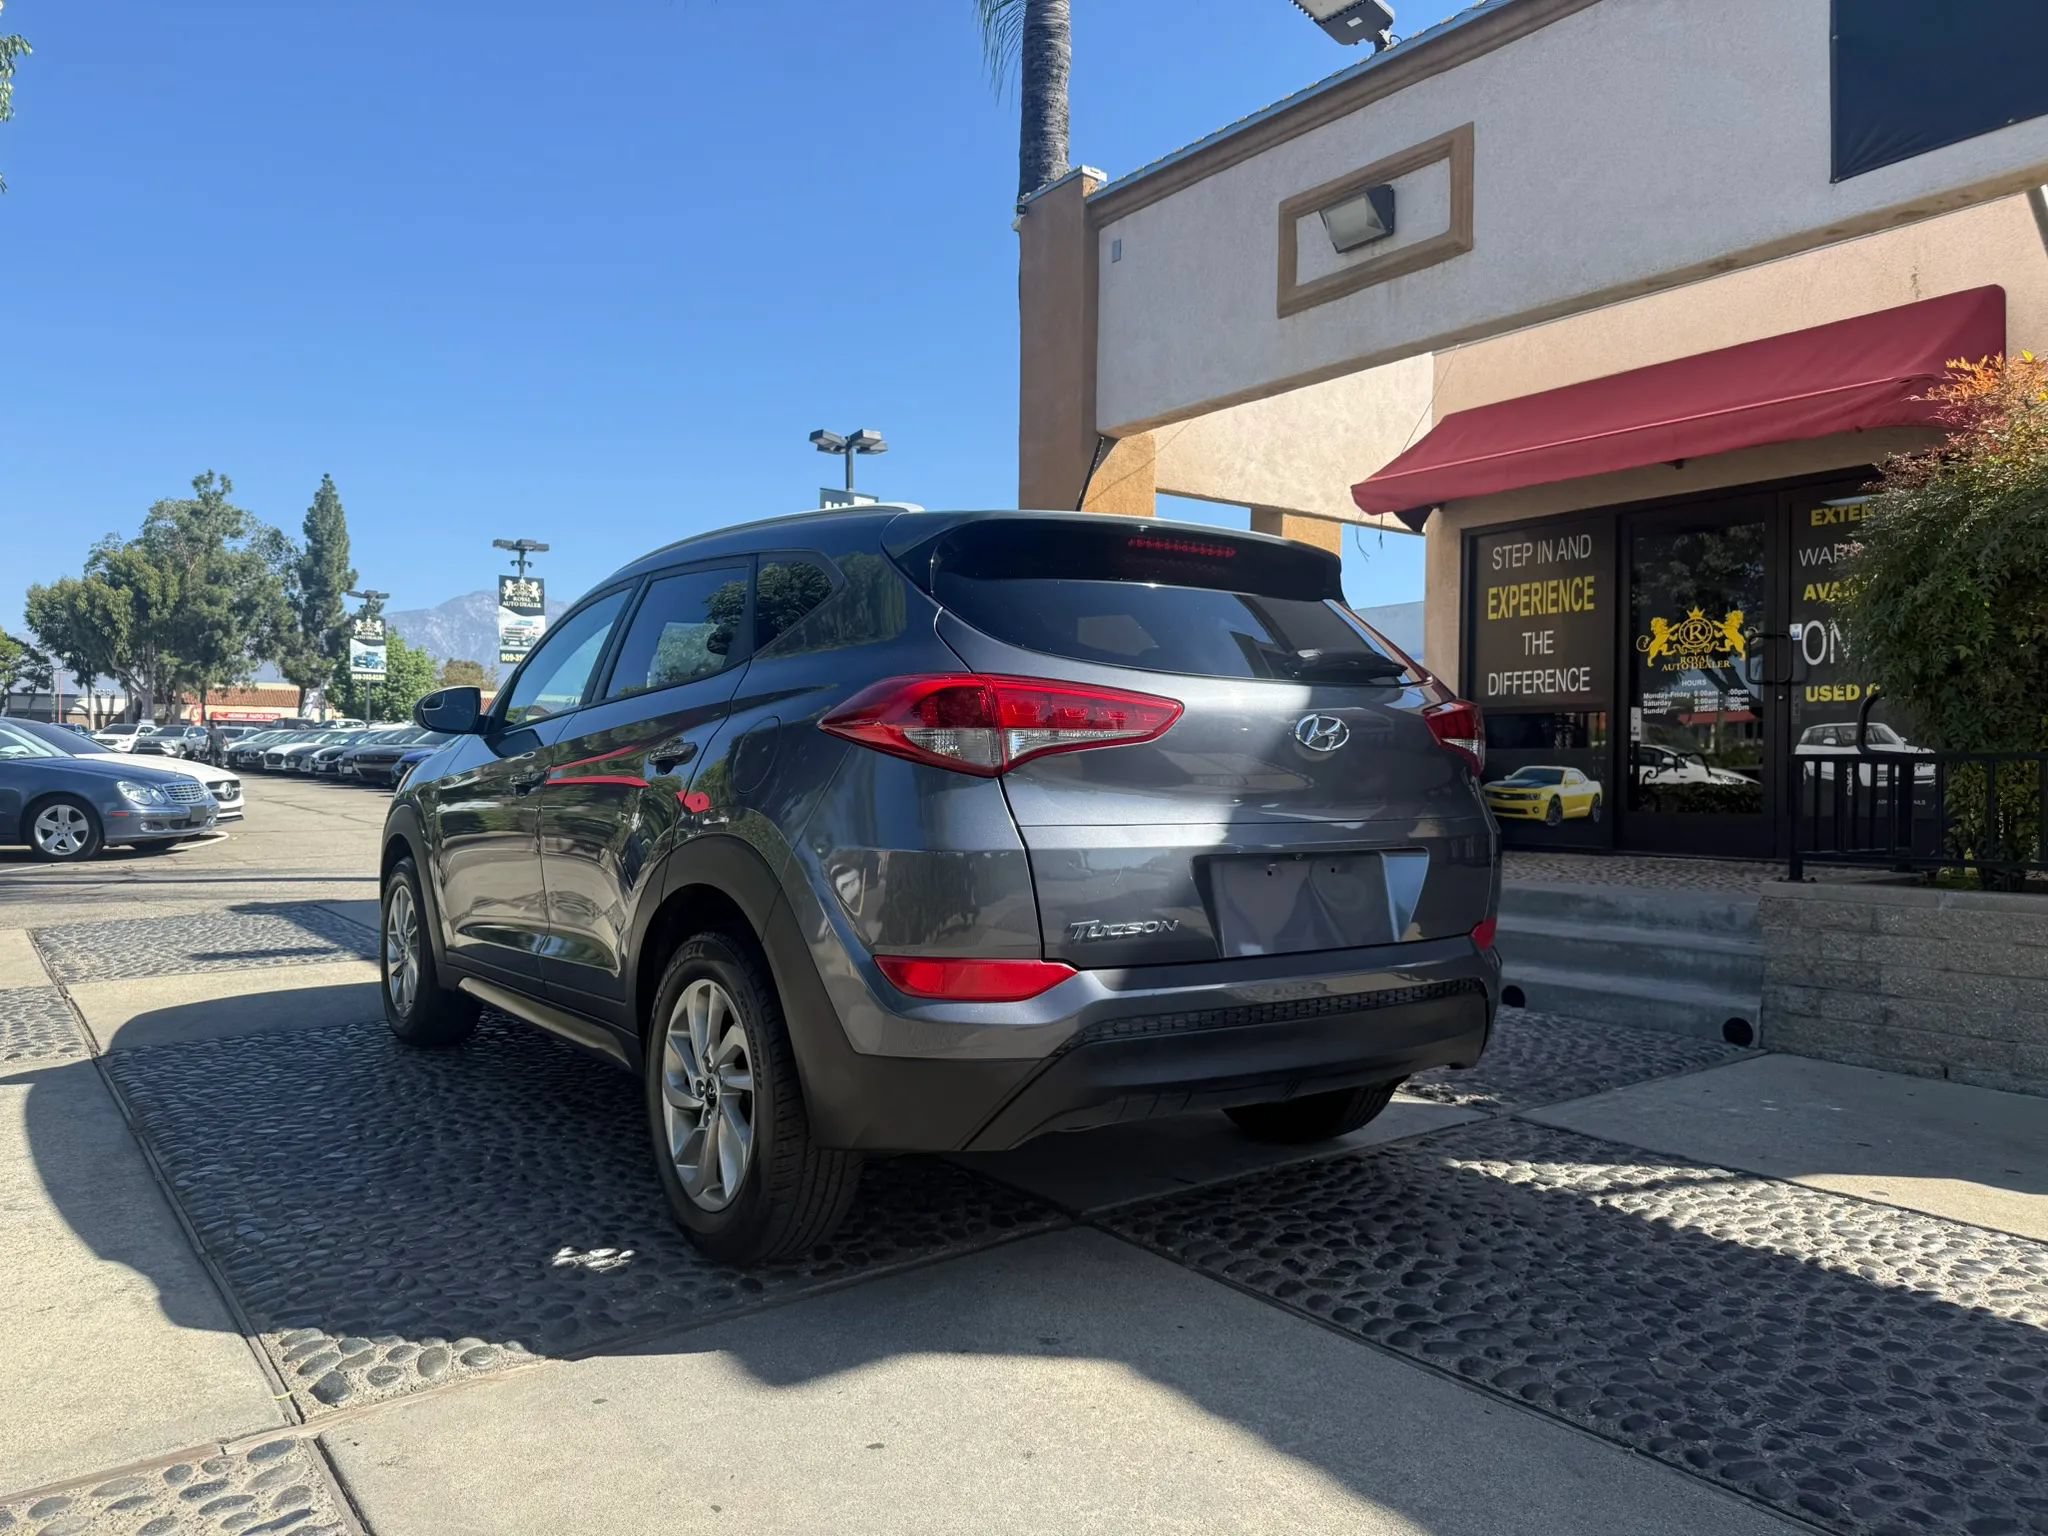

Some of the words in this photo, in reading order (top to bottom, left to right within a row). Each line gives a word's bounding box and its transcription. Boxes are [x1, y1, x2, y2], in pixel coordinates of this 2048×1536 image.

[1492, 542, 1533, 570] STEP
[1537, 539, 1553, 565] IN
[1556, 534, 1593, 562] AND
[1487, 576, 1595, 620] EXPERIENCE
[1522, 630, 1554, 656] THE
[1661, 662, 1689, 671] AUTO
[1691, 660, 1730, 669] DEALER
[1680, 655, 1711, 664] ROYAL
[1487, 667, 1591, 696] DIFFERENCE
[1681, 679, 1707, 687] HOURS
[1805, 684, 1860, 702] USED
[1643, 700, 1671, 708] Saturday
[1070, 919, 1179, 940] TUCSON
